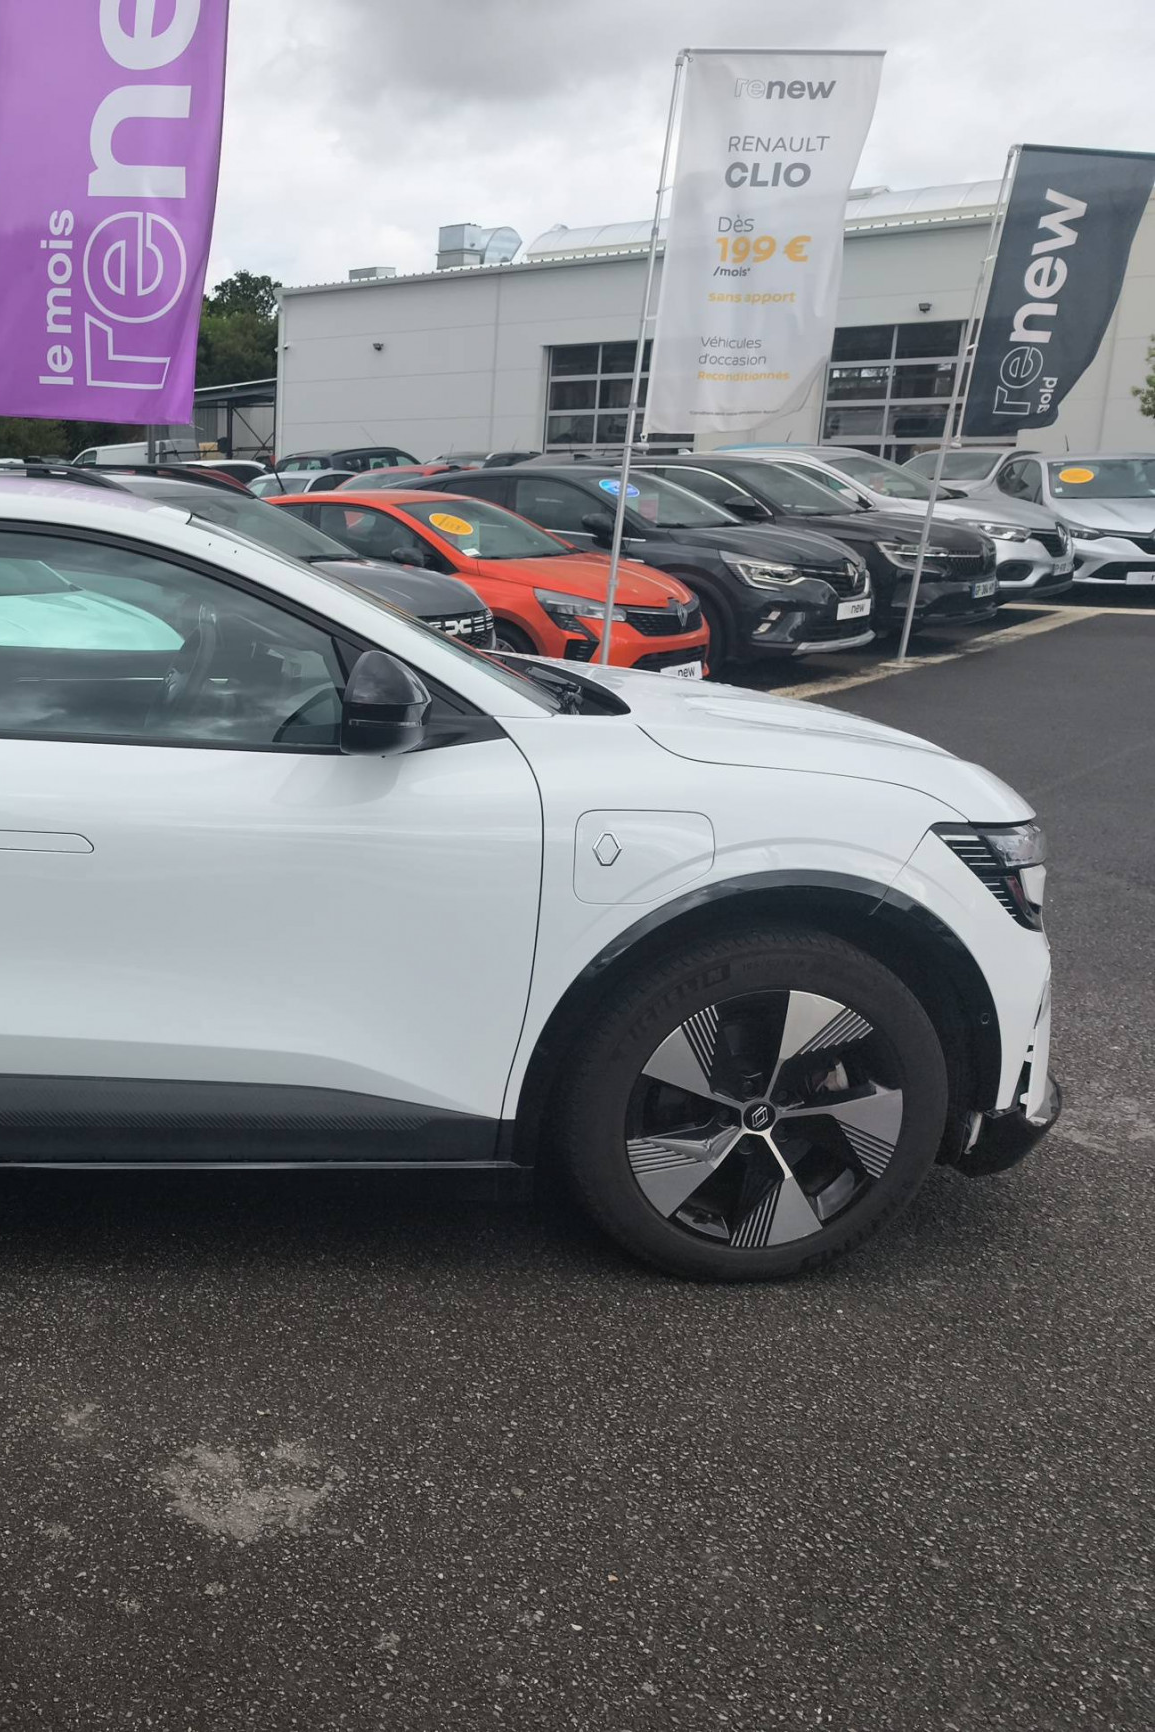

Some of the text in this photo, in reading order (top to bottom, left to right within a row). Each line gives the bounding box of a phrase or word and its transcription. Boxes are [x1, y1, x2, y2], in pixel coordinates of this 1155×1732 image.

[734, 78, 836, 100] renew
[728, 136, 830, 152] RENAULT
[725, 162, 811, 188] CLIO
[718, 215, 755, 233] Dès
[716, 235, 812, 263] 199 €
[39, 209, 75, 385] le mois
[993, 188, 1088, 416] renew
[701, 336, 763, 349] Véhicules
[698, 353, 767, 367] d'occasion
